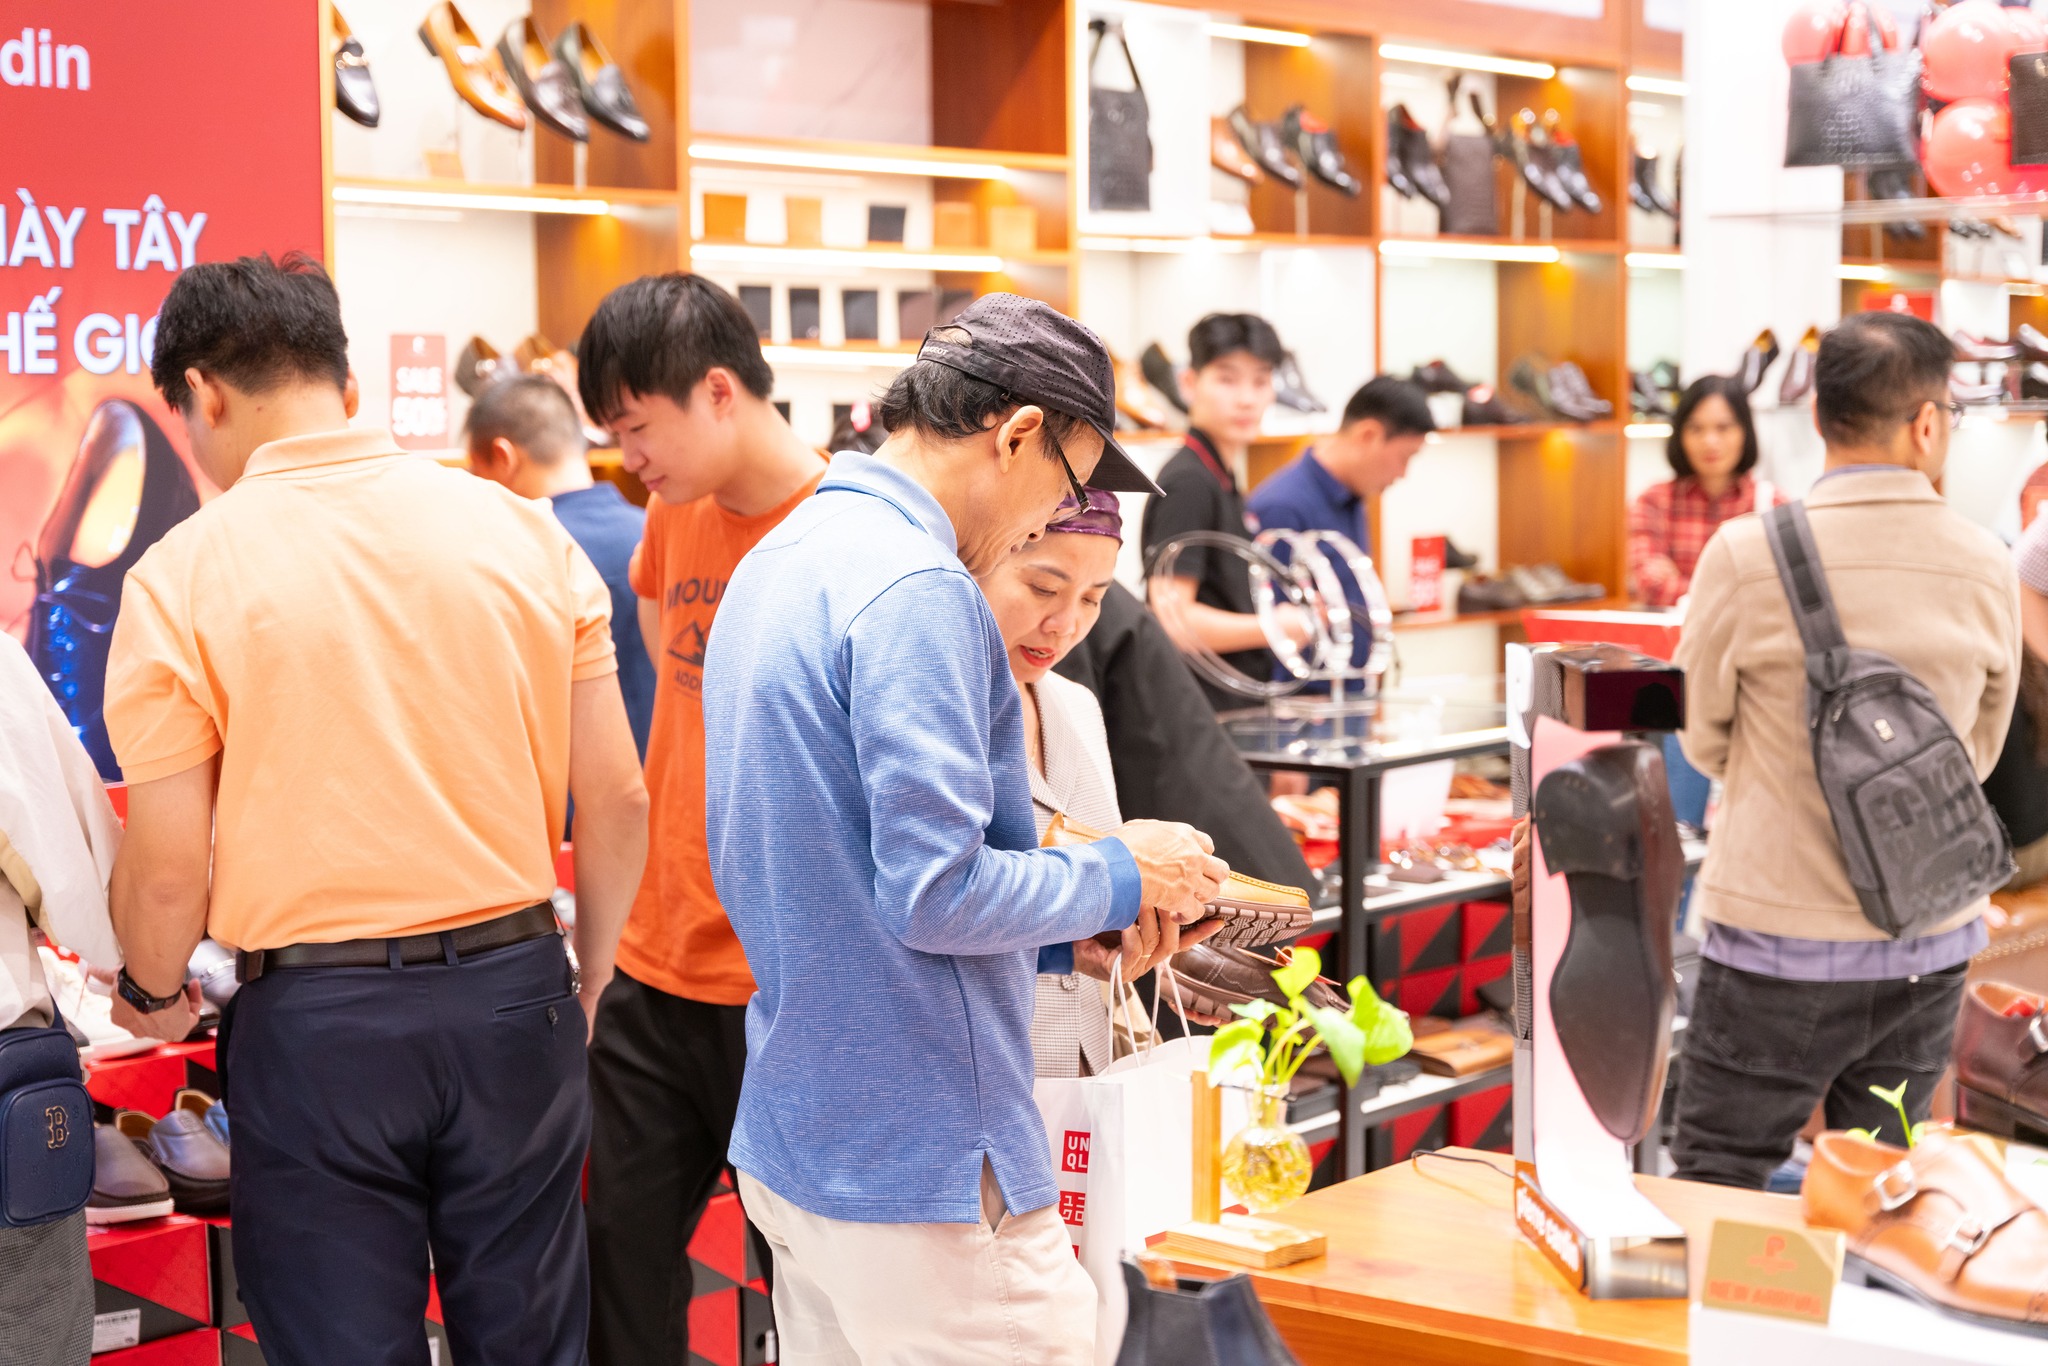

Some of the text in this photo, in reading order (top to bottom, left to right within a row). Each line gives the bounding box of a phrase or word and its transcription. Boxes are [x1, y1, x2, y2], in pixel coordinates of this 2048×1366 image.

[0, 27, 91, 91] din
[103, 194, 208, 271] TÂY
[668, 578, 728, 611] MOU
[45, 1105, 70, 1149] B
